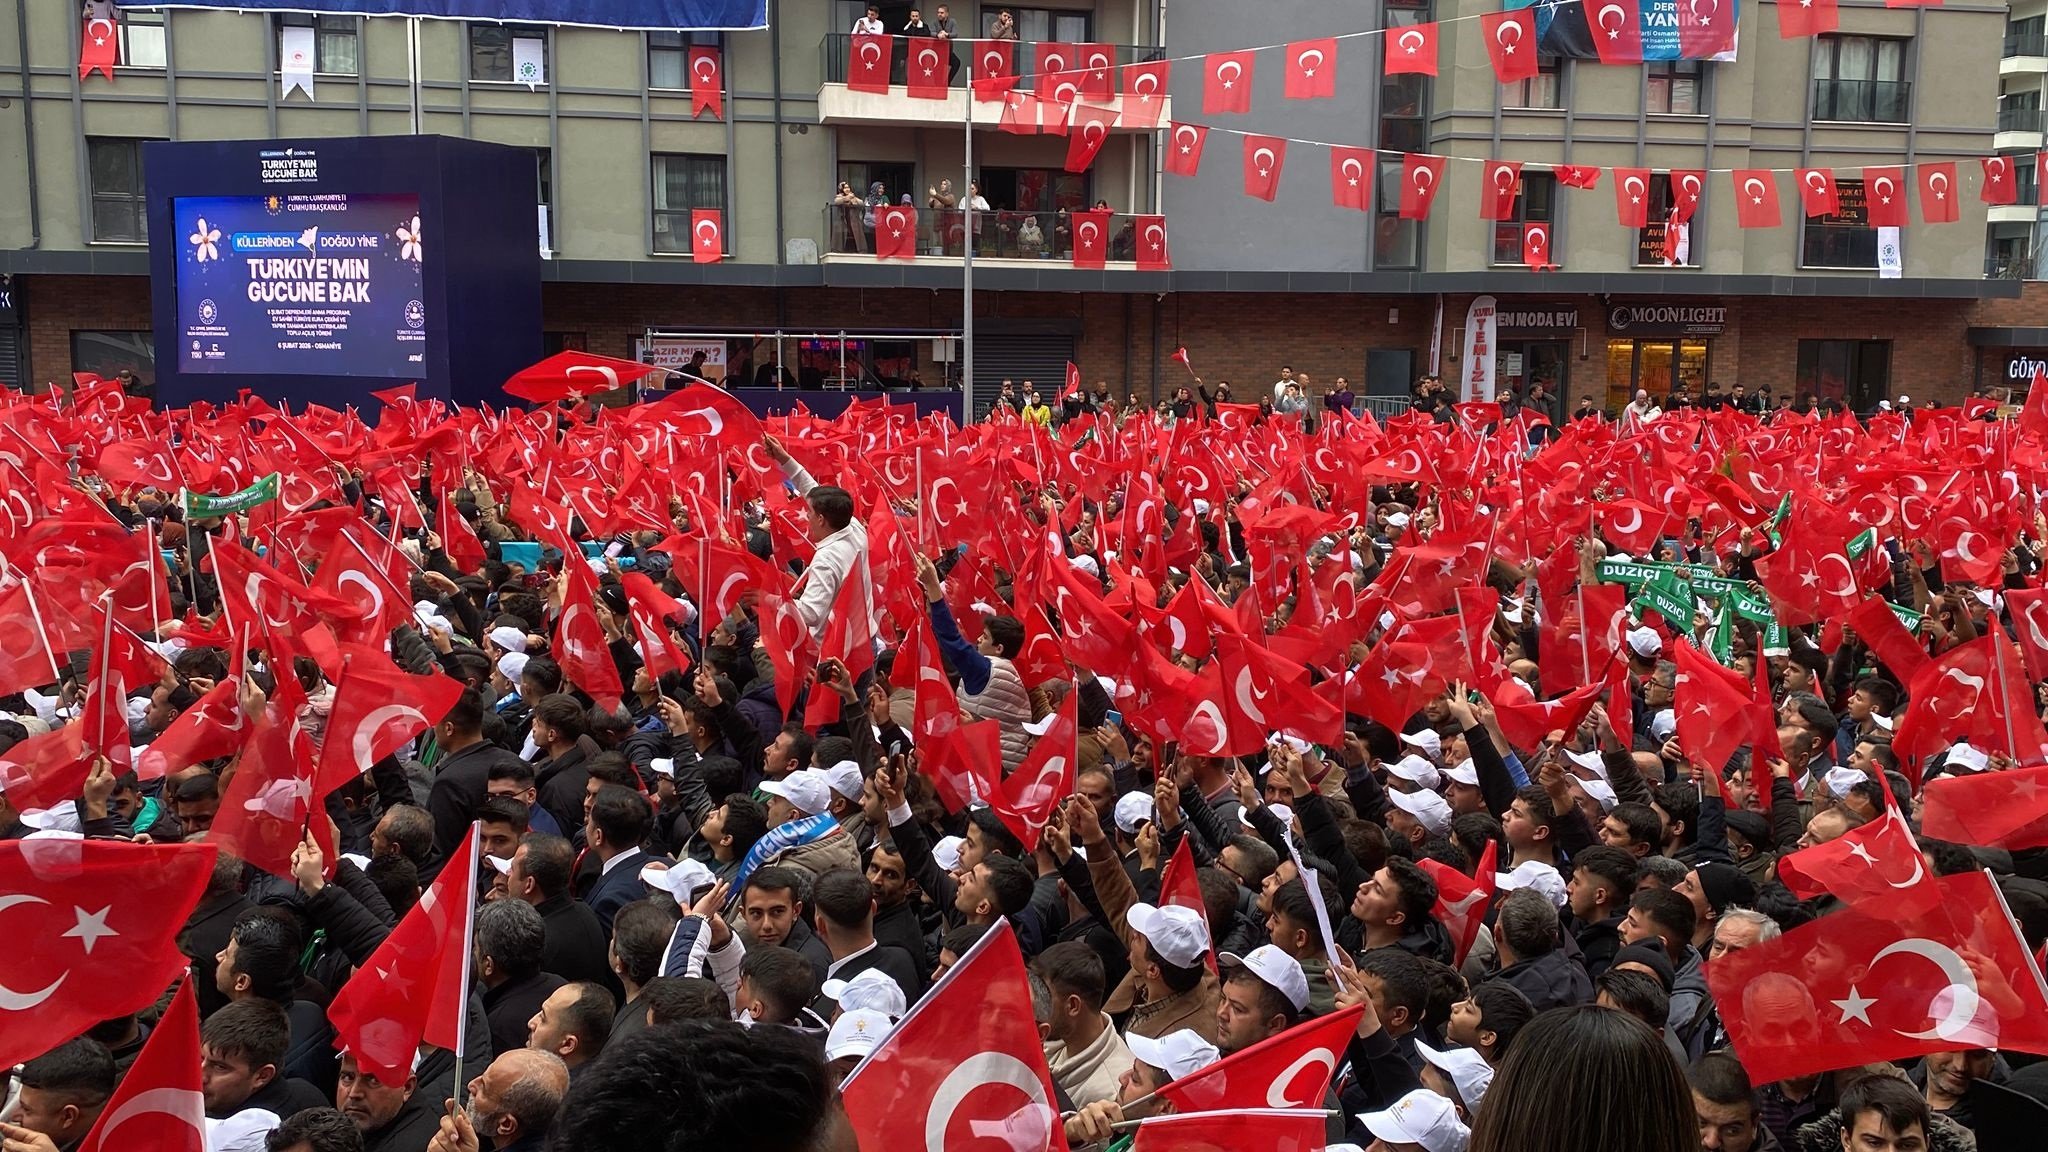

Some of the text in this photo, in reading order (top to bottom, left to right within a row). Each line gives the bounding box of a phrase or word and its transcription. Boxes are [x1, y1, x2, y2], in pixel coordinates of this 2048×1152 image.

[1654, 3, 1688, 11] DERYA
[1645, 12, 1699, 27] YANIK
[299, 169, 317, 178] BAK
[1840, 209, 1858, 218] ÜCEL
[1648, 229, 1664, 237] AVU
[237, 234, 378, 247] KÜLLERİNDEN DOĞDU YİNE
[1650, 250, 1665, 258] YÜC
[329, 281, 371, 302] BAK
[1516, 311, 1554, 327] MODA
[1556, 310, 1577, 327] EVİ
[1631, 306, 1727, 322] MOONLIGHT
[314, 341, 341, 350] OSMANİYE
[653, 347, 678, 355] AZIR
[2010, 356, 2048, 378] GÖKD
